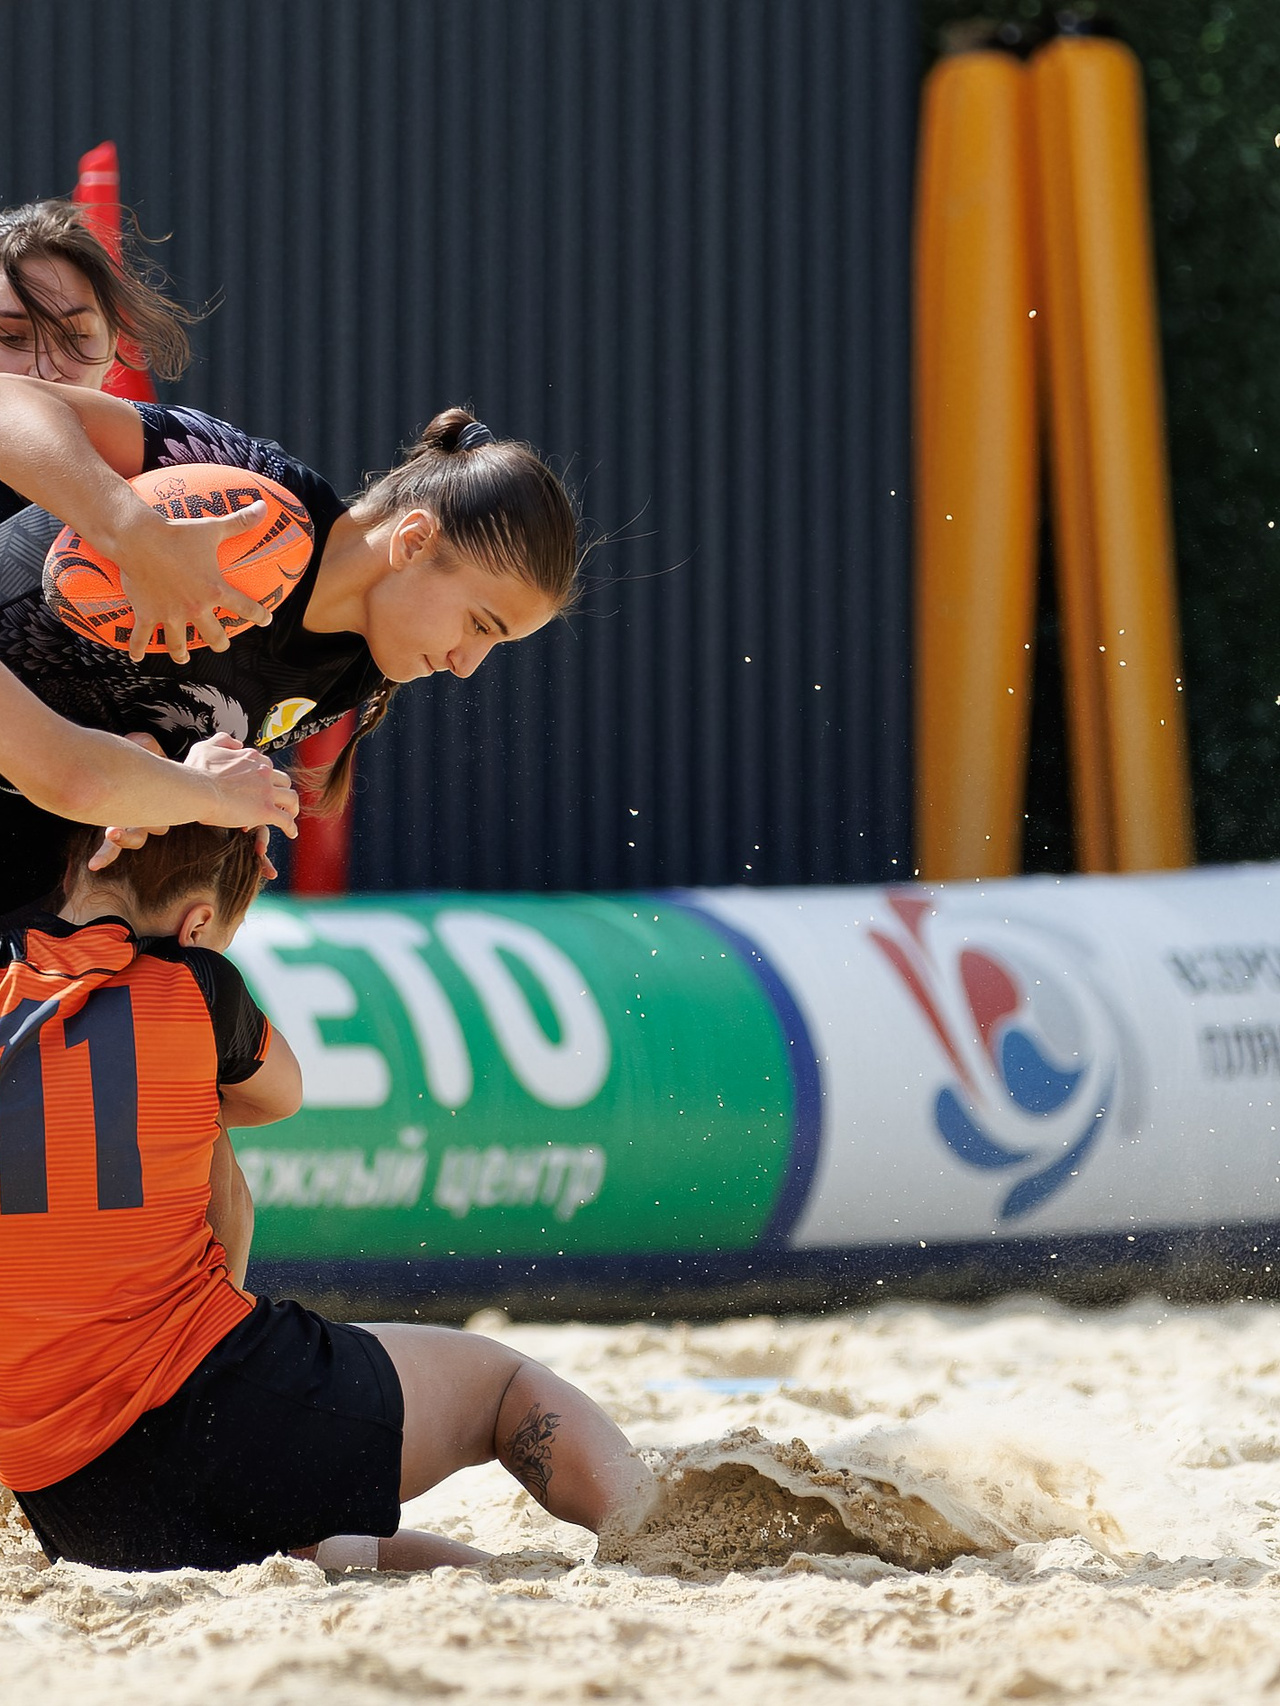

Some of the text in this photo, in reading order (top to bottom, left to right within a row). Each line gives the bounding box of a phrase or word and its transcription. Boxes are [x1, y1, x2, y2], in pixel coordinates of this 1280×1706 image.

[228, 904, 612, 1111] ЕТО
[238, 1126, 607, 1221] жный центр
